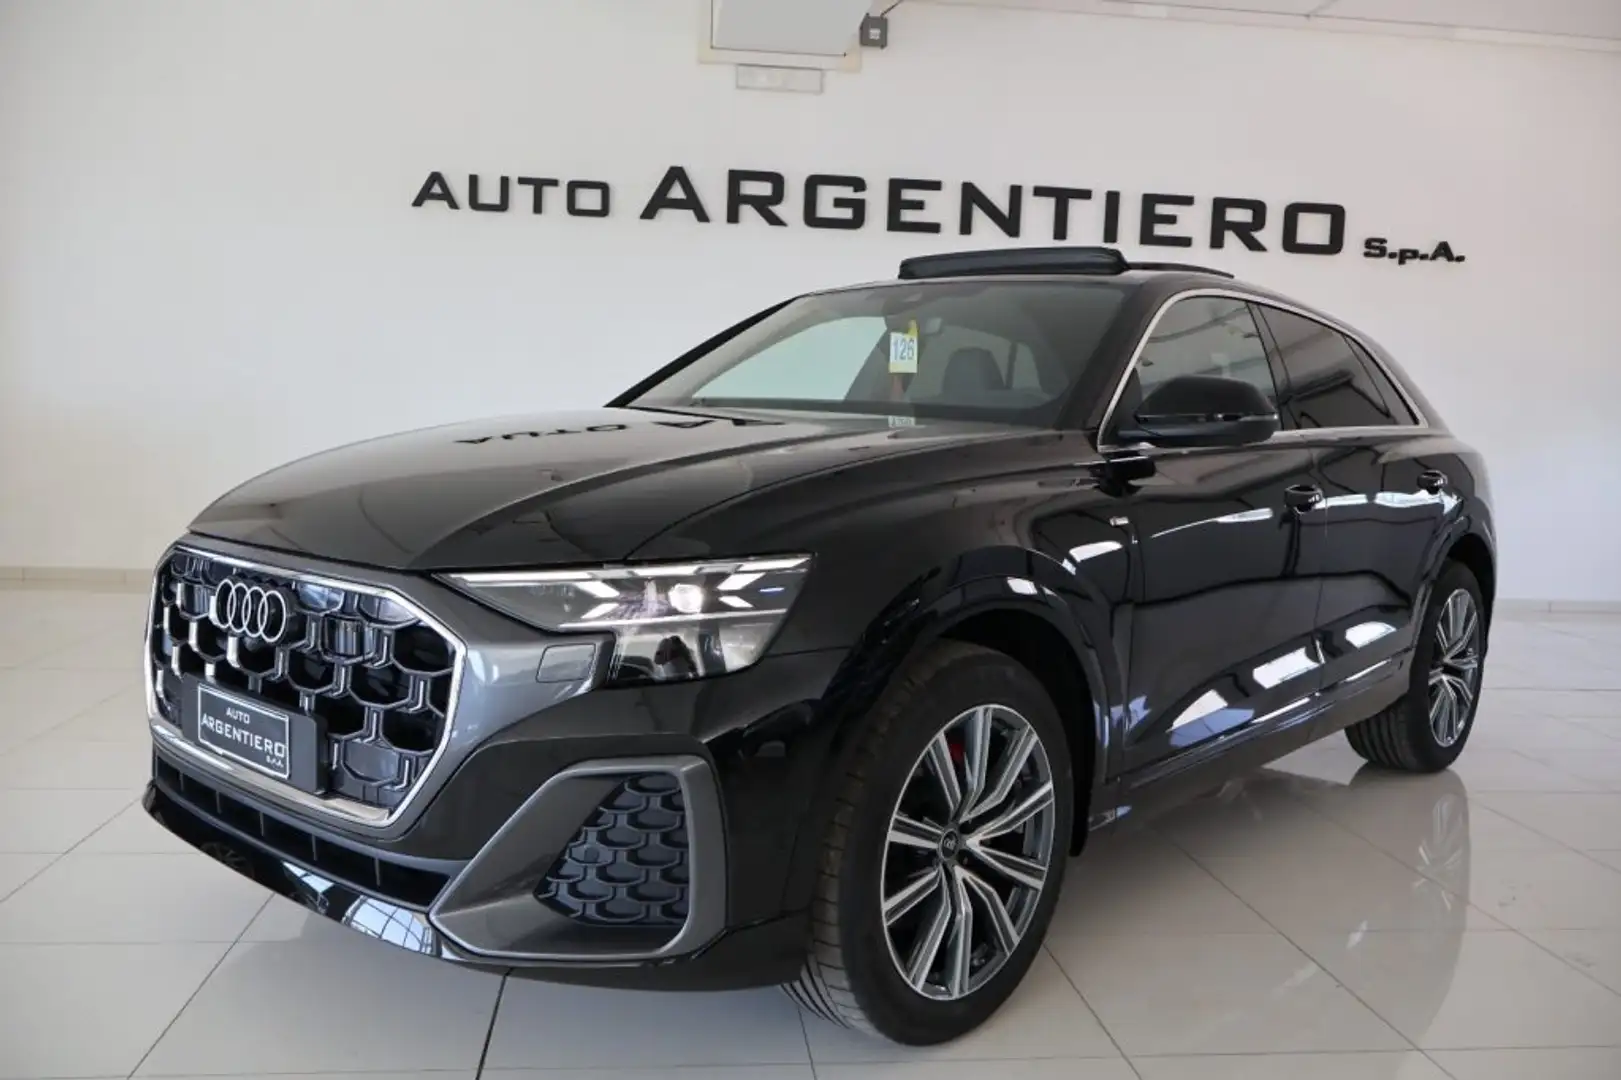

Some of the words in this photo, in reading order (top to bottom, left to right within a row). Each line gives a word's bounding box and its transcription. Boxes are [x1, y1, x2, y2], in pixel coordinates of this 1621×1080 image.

[412, 172, 610, 217] AUTO
[640, 166, 1346, 256] ARGENTIERO
[1363, 238, 1465, 265] S.p.A.
[201, 713, 286, 758] ARGENTIERO
[226, 707, 250, 724] AUTO
